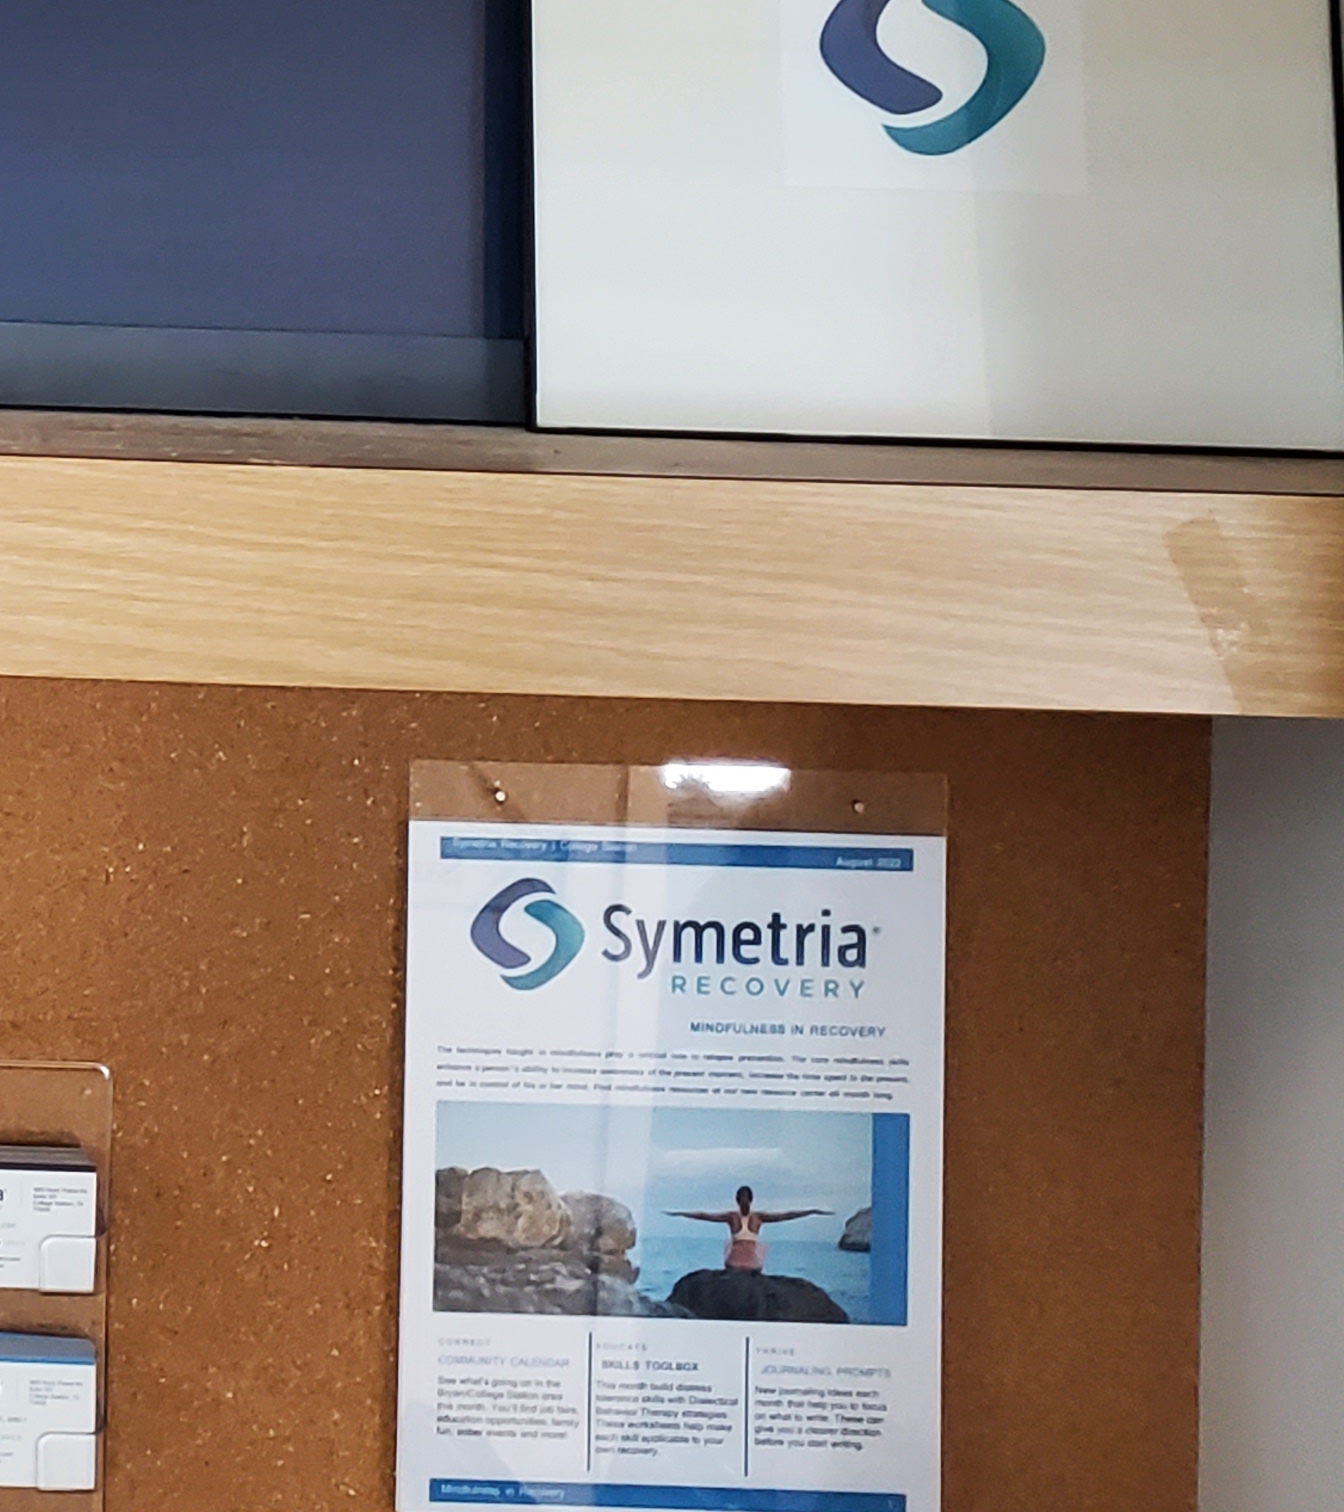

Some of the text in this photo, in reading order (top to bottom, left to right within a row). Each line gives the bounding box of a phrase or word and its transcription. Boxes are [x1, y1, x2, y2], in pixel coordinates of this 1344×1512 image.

[671, 974, 866, 999] RECOVERY
[690, 1022, 886, 1038] MINDFULNESS IN RECOVERY
